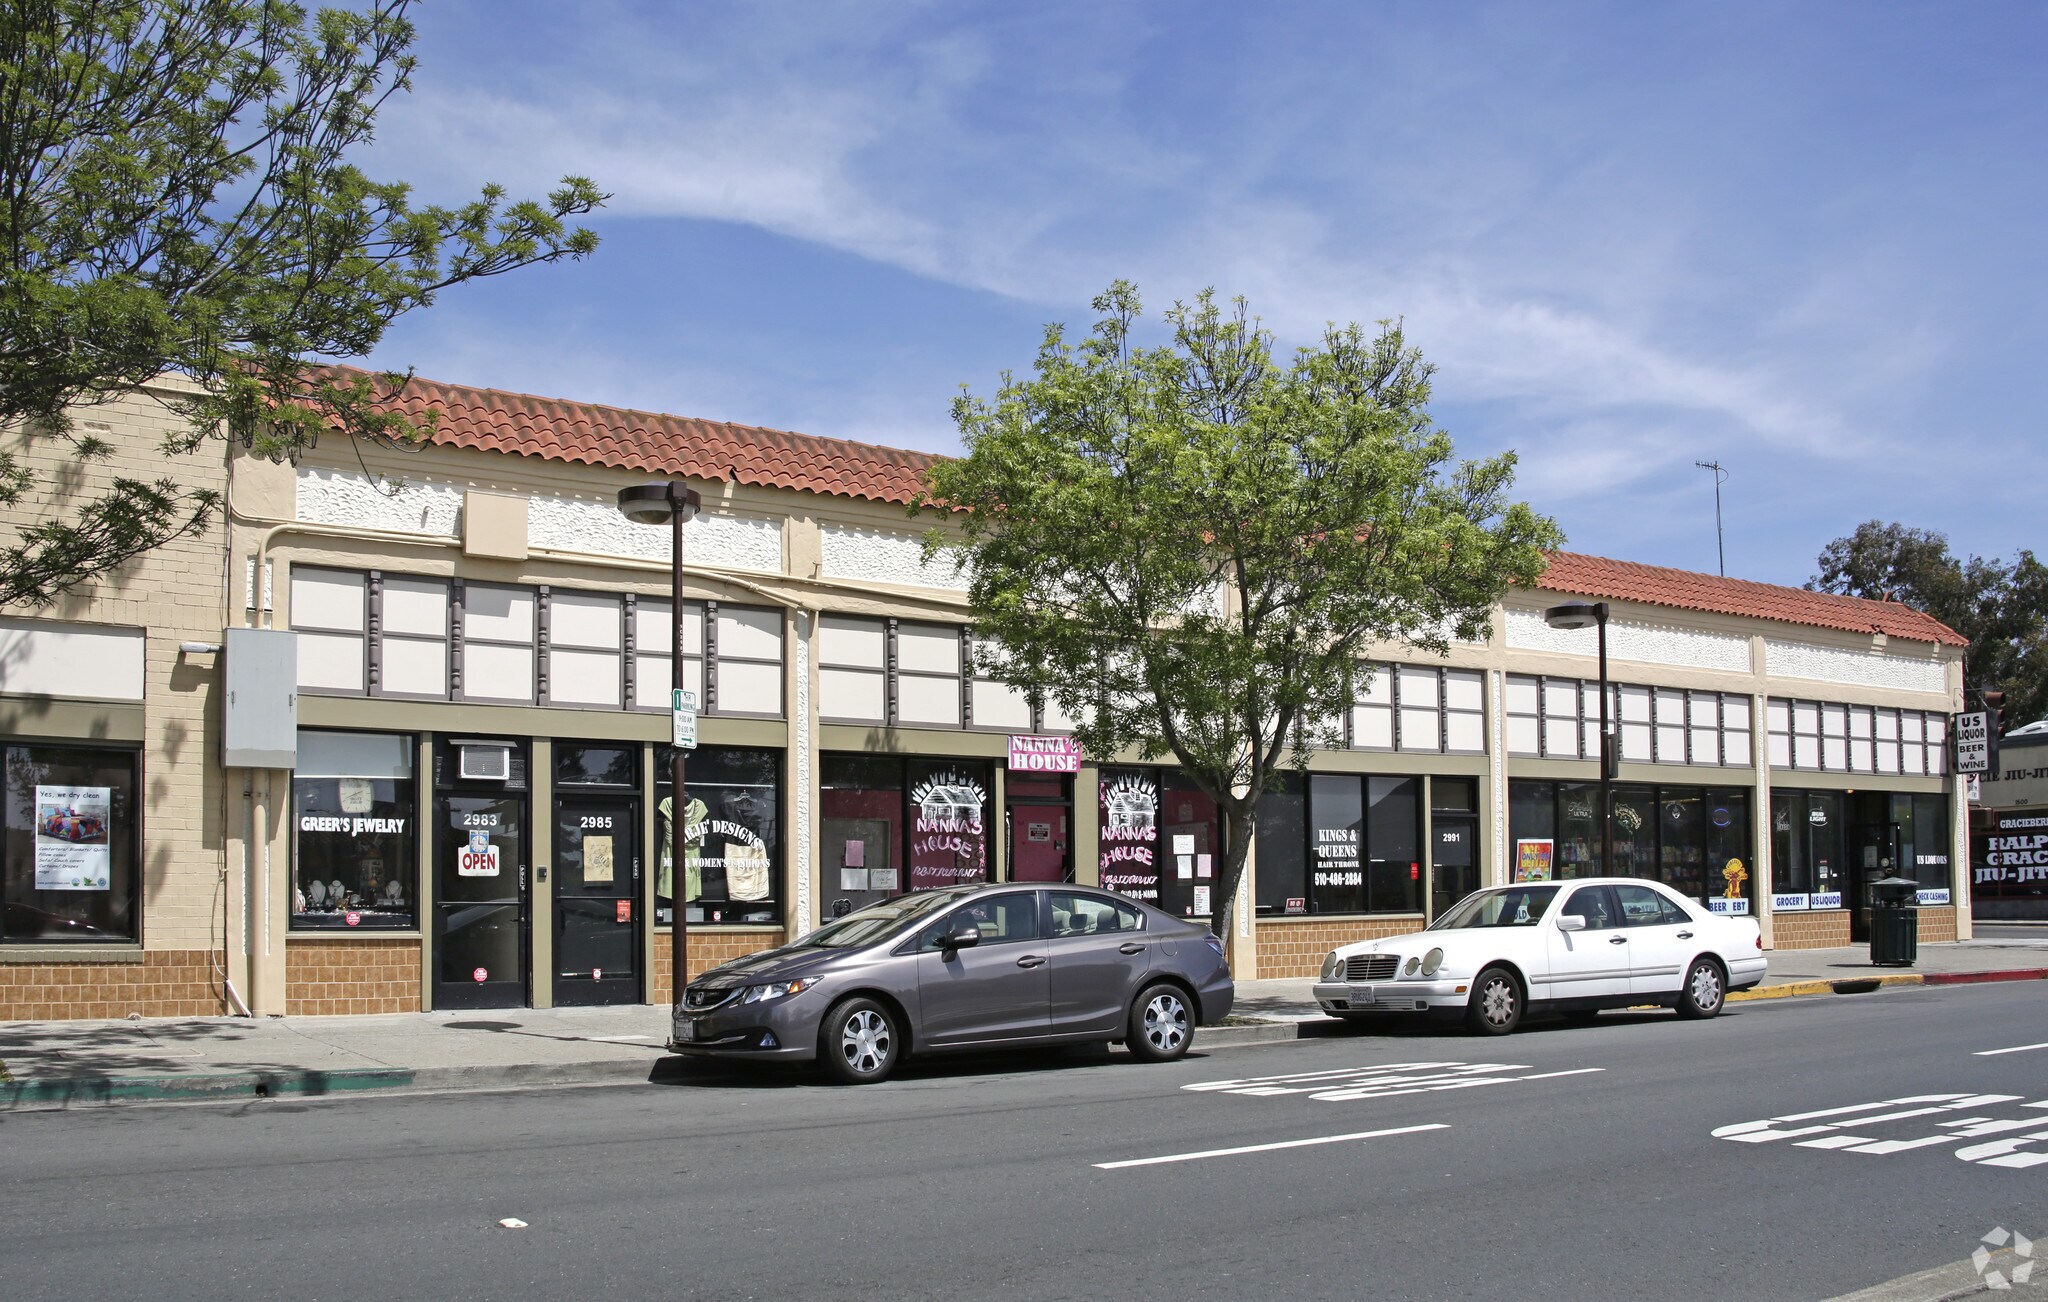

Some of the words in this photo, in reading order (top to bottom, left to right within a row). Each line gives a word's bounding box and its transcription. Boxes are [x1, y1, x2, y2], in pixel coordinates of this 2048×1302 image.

[1962, 716, 1981, 728] US
[1958, 728, 1985, 741] LIQUOR
[1012, 736, 1079, 755] NANNA'S
[1959, 744, 1985, 754] BEER
[1012, 753, 1078, 771] HOUSE
[1960, 761, 1986, 770] WINE
[69, 791, 80, 799] dry
[463, 814, 498, 826] 2983
[580, 816, 613, 829] 2985
[301, 817, 350, 832] GREER'S
[352, 818, 406, 837] JEWELRY
[916, 818, 983, 835] NANNA'S
[1318, 829, 1348, 842] KINGS
[1349, 829, 1357, 842] &
[1443, 833, 1460, 842] 2991
[914, 835, 972, 859] HOUSE
[1318, 844, 1357, 858] QUEENS
[463, 853, 496, 870] OPEN
[692, 858, 730, 868] WOMEN'S
[1104, 846, 1153, 868] HOUSE
[1917, 855, 1924, 865] US
[1925, 855, 1948, 865] LIQUORS
[1776, 896, 1804, 907] GROCERY
[1811, 896, 1819, 906] US
[1820, 895, 1841, 906] LIQUOR
[1930, 893, 1948, 901] CASHING
[1708, 902, 1727, 912] BEER
[1733, 901, 1746, 912] EBT
